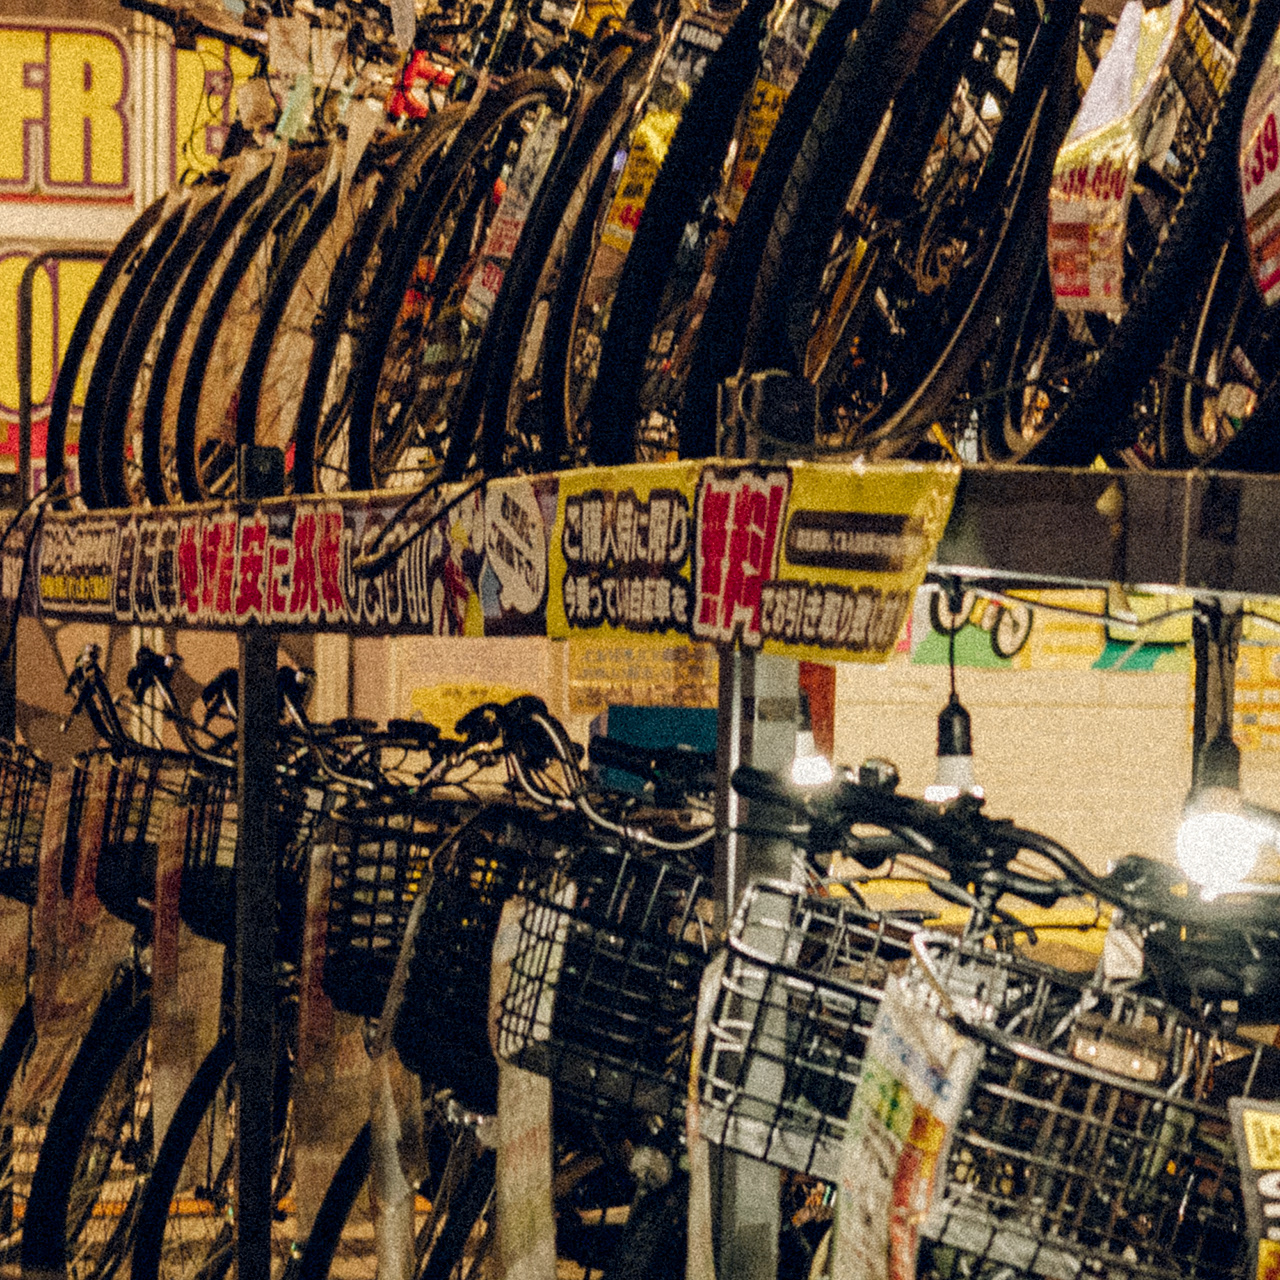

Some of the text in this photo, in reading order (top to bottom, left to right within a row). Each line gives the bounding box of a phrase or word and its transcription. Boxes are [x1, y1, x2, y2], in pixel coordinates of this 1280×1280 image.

[563, 498, 689, 563] ご購入時に限り
